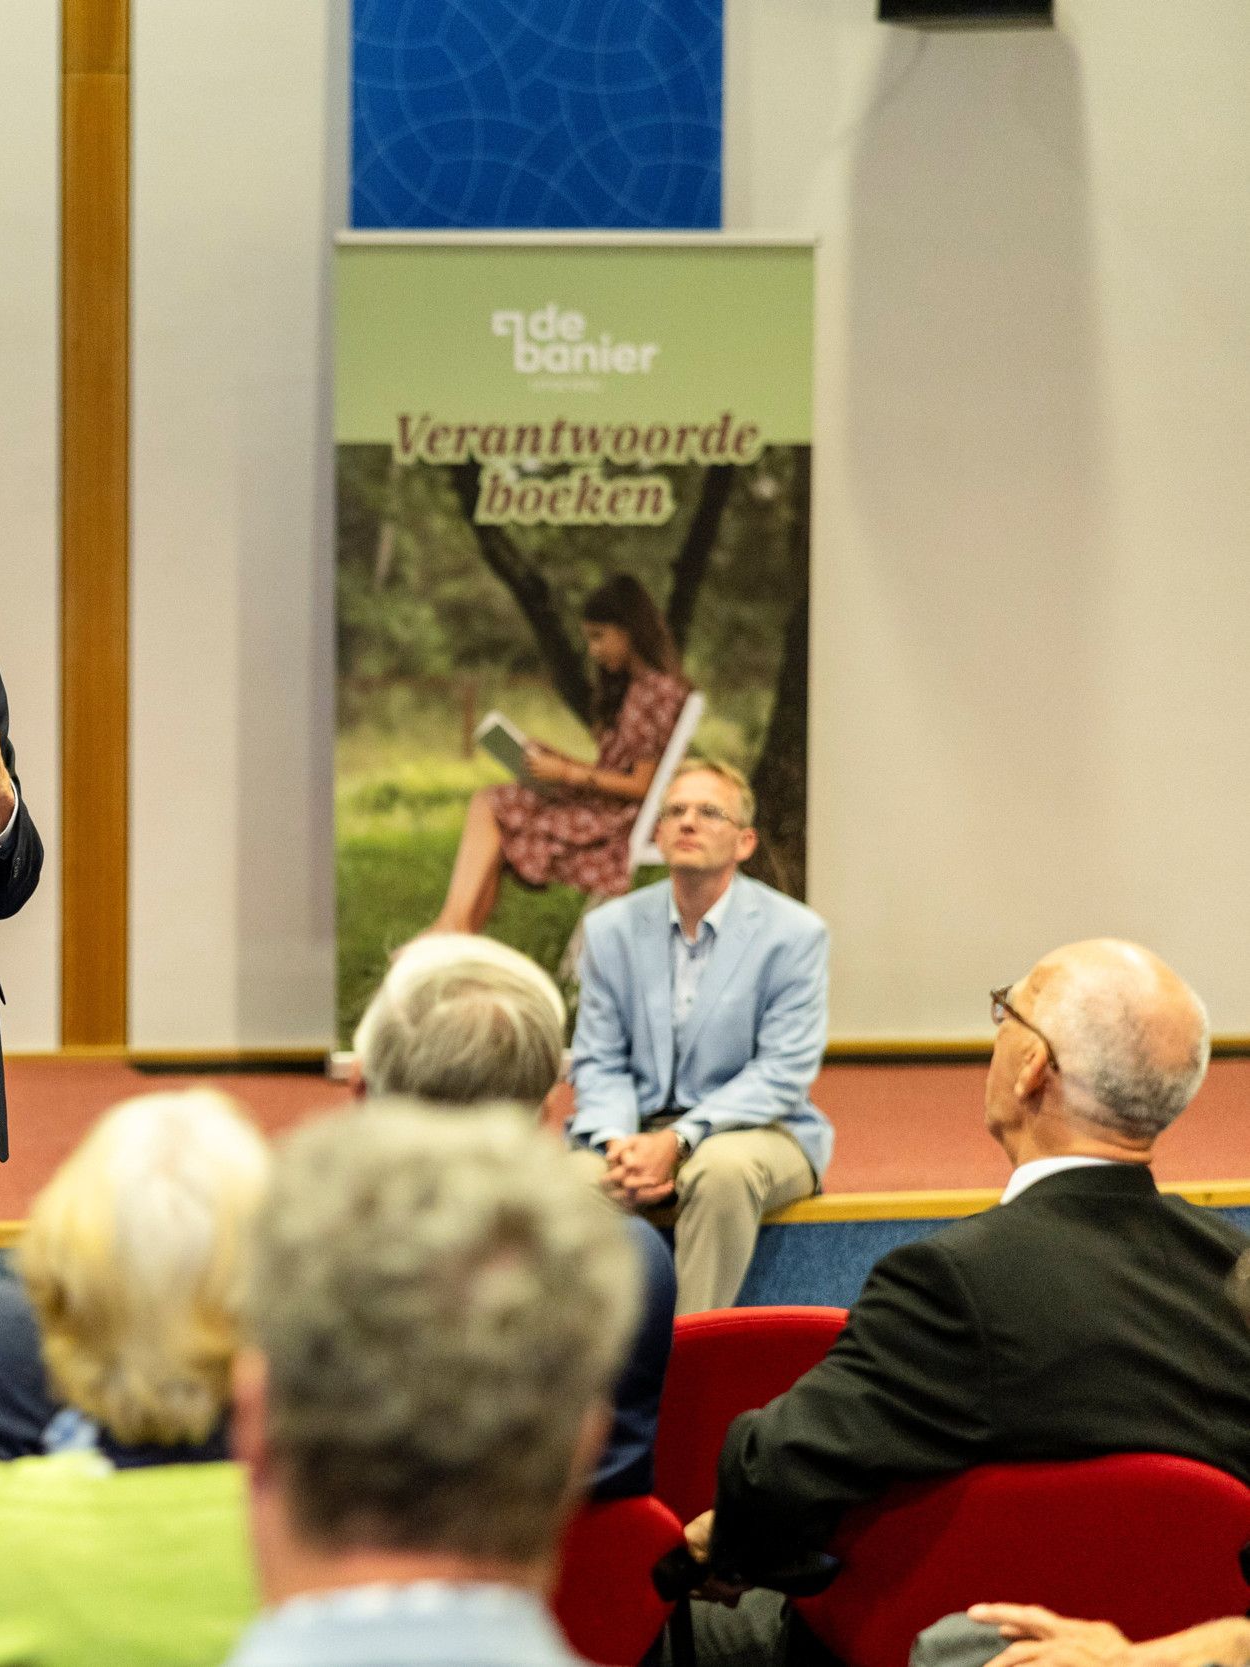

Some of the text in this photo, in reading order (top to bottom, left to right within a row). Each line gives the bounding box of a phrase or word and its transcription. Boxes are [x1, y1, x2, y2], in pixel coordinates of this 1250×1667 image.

[529, 303, 586, 340] de
[514, 334, 658, 373] banier
[396, 411, 759, 458] Verantwoorde
[482, 471, 666, 517] boeken
